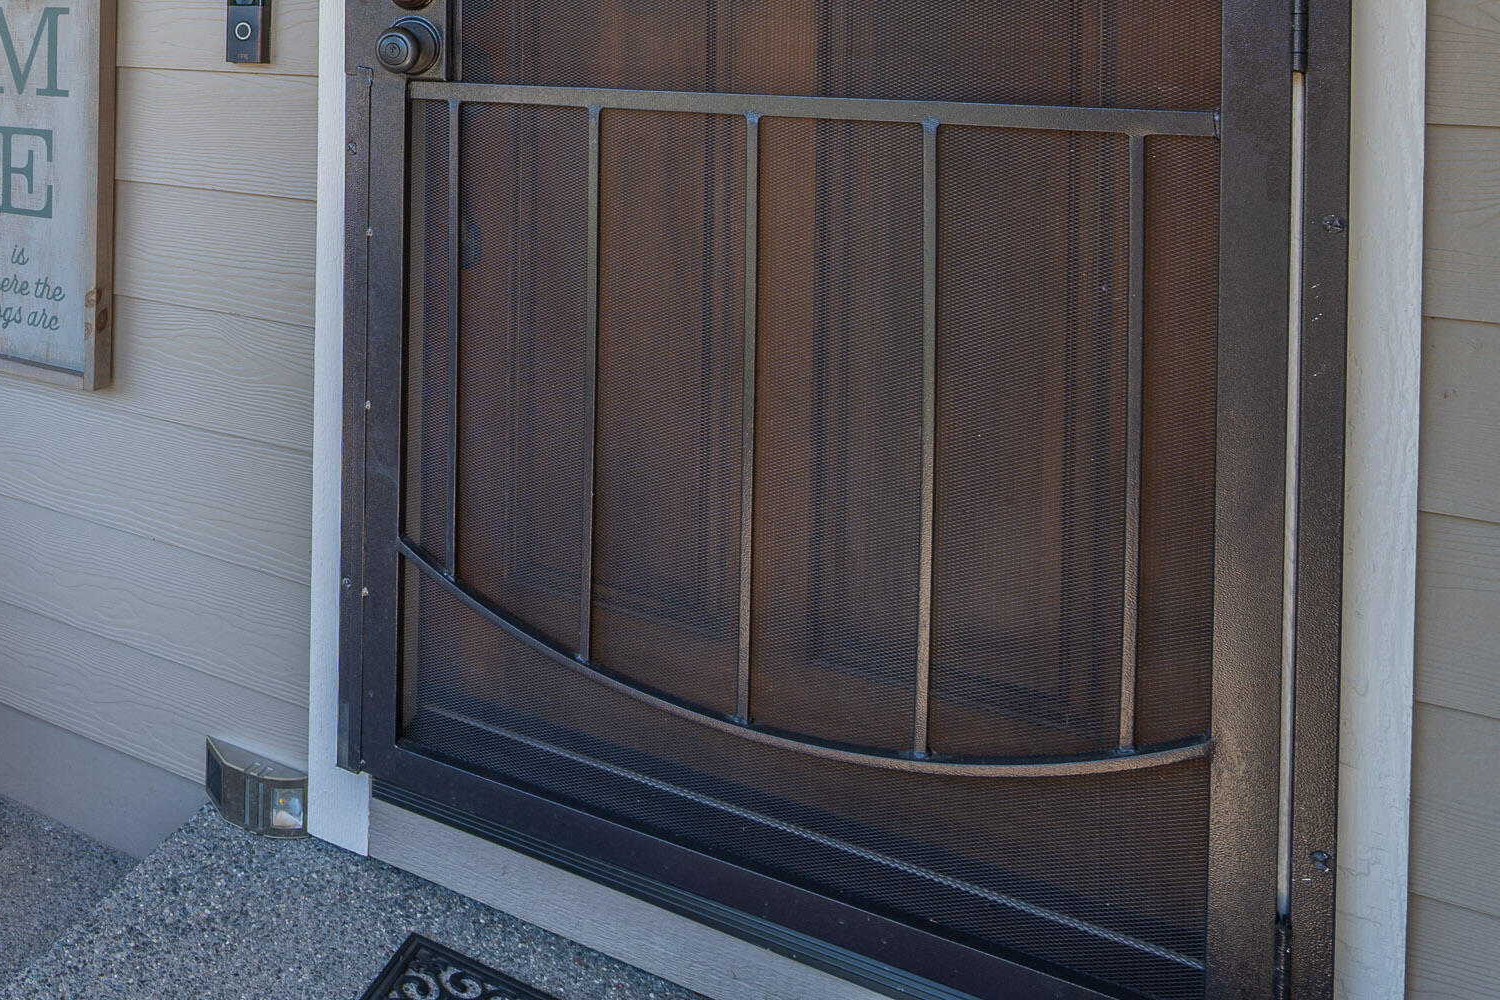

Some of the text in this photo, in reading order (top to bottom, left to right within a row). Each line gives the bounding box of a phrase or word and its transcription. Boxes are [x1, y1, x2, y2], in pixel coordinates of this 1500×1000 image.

[10, 244, 30, 266] is
[34, 276, 66, 302] the
[27, 308, 60, 331] are
